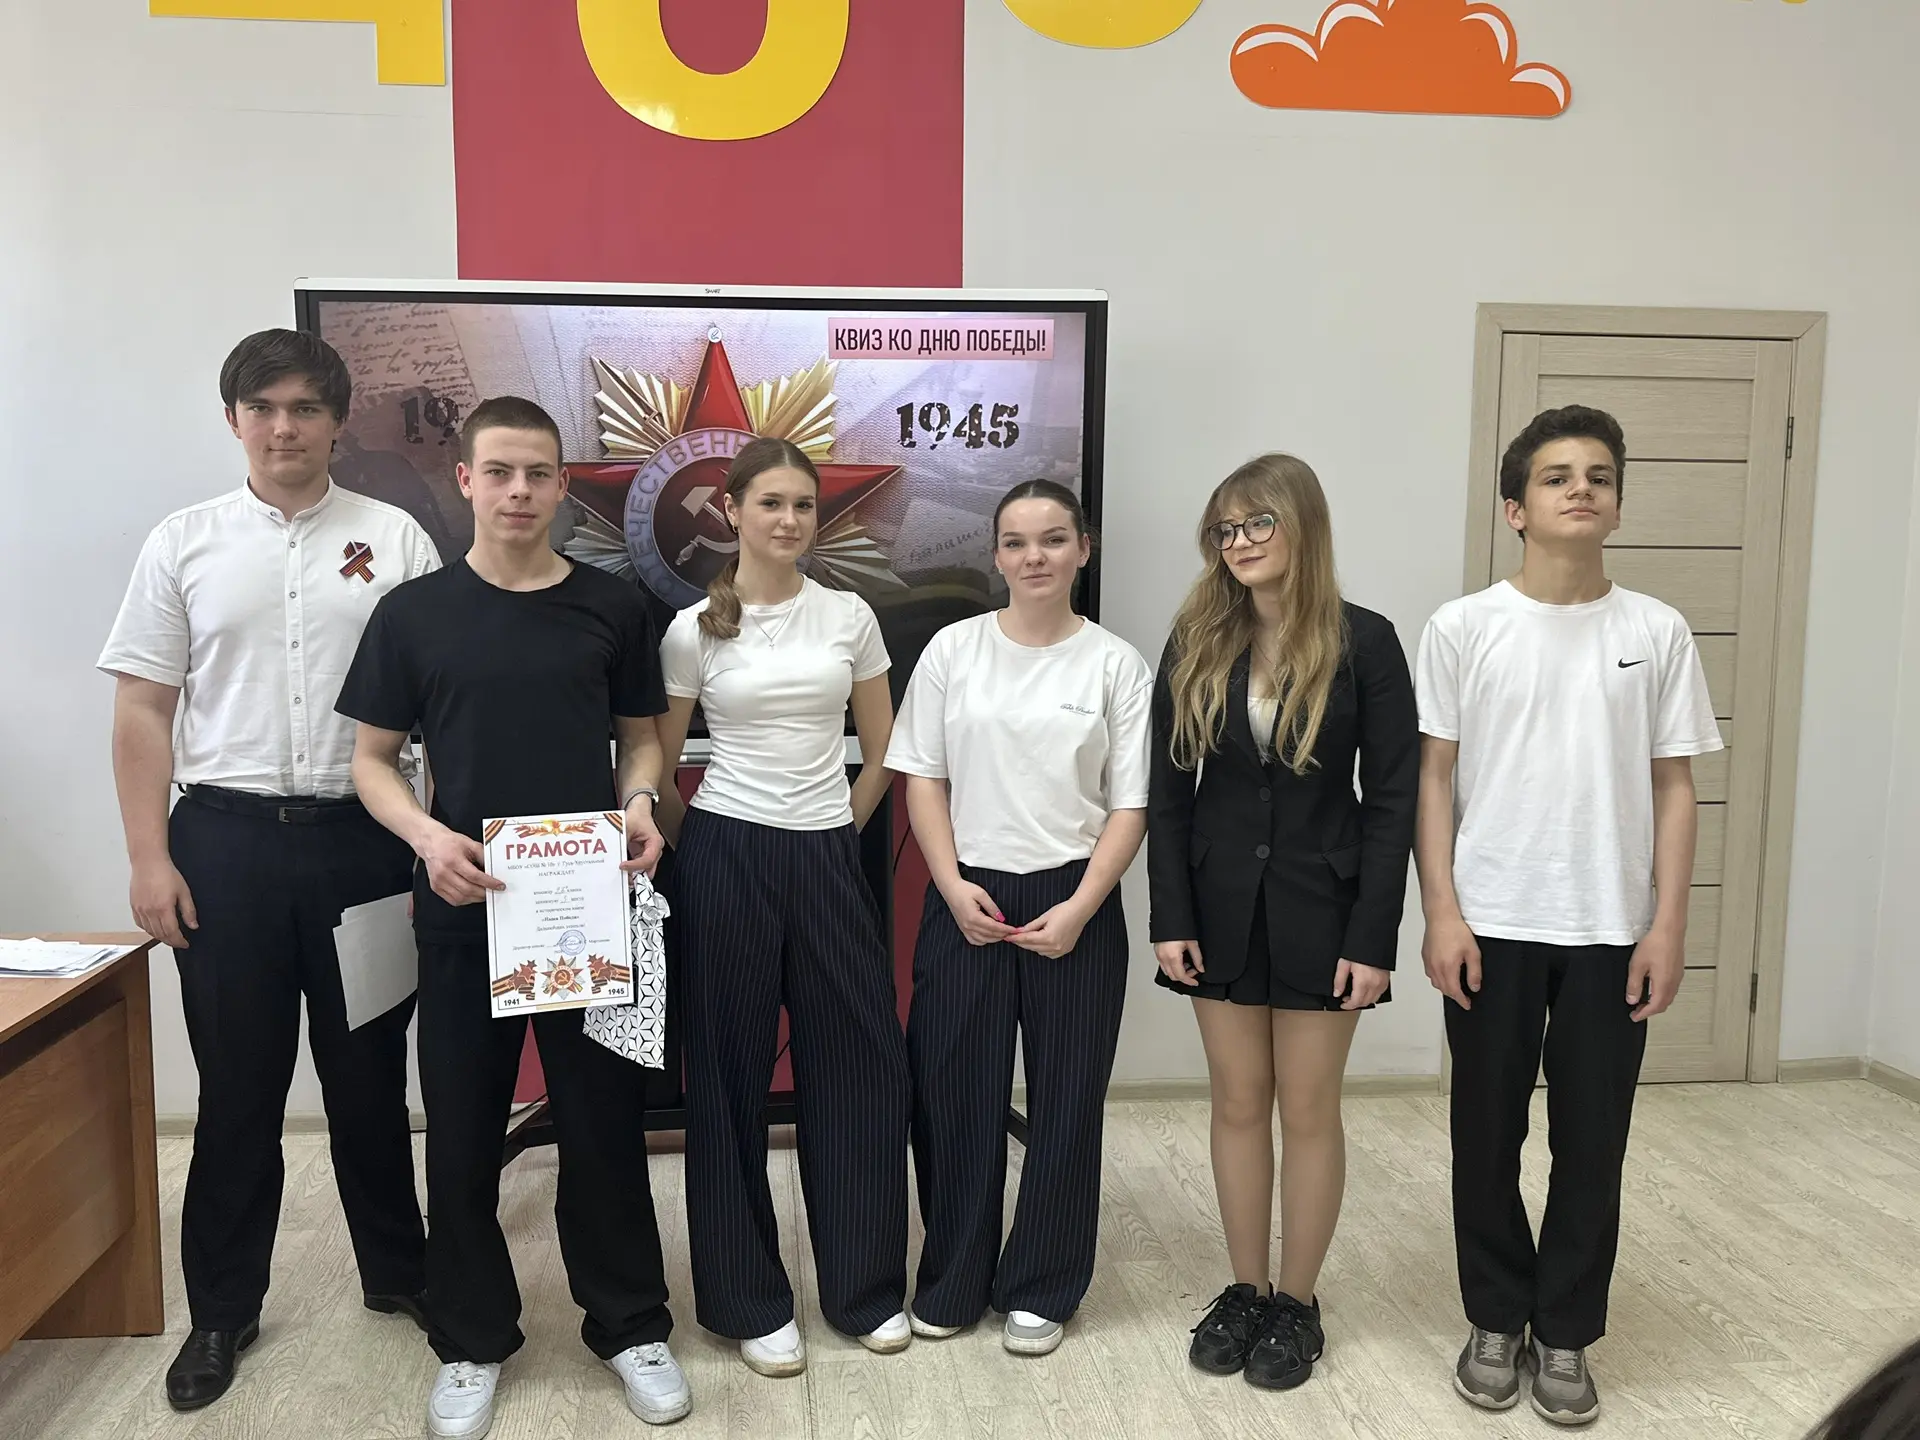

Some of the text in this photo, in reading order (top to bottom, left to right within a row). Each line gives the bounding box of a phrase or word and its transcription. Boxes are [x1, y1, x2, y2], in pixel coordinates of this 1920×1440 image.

[835, 328, 1046, 355] КВИЗ КО ДНЮ ПОБЕДЫ!
[400, 396, 460, 446] 19
[896, 402, 1020, 450] 1945
[505, 838, 608, 860] ГРАМОТА
[503, 998, 520, 1007] 1941
[608, 987, 625, 996] 1945
